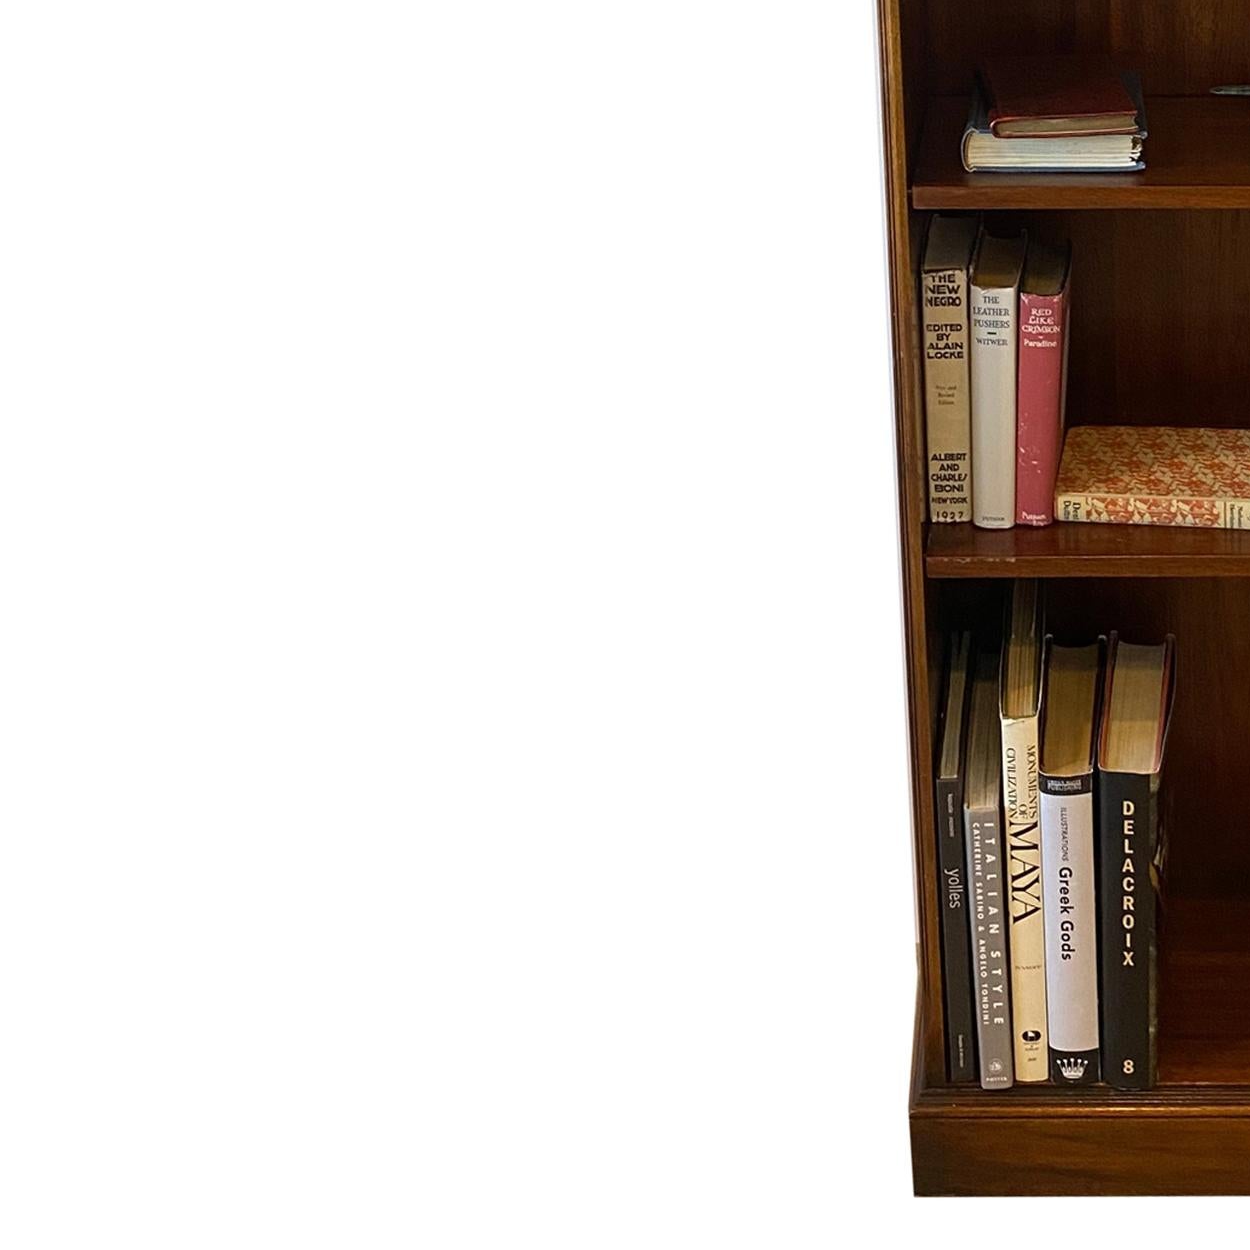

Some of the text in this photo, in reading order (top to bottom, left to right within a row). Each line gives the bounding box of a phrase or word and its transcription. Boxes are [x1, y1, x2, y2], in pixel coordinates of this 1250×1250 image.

[931, 273, 956, 283] THE
[925, 285, 961, 295] NEW
[925, 296, 962, 307] NEGRO
[982, 295, 1000, 304] THE
[972, 307, 1010, 317] LEATHER
[1031, 308, 1053, 316] RED
[926, 323, 963, 331] EDITED
[973, 319, 1011, 329] PUSHERS
[936, 333, 951, 341] BY
[975, 337, 1009, 346] WITWER
[927, 342, 964, 350] ALAIN
[926, 351, 964, 360] LOCKE
[931, 453, 967, 462] ALBERT
[939, 463, 960, 472] AND
[930, 473, 968, 482] CHARLES
[934, 484, 964, 493] BONI
[936, 511, 964, 520] 1927
[1006, 747, 1018, 819] CIVILIZATION
[1060, 806, 1070, 862] ILLUSTRATIONS
[972, 822, 982, 876] CATHERINE
[1009, 819, 1041, 925] MAYA
[944, 868, 963, 909] yolles
[1122, 800, 1135, 967] DELACROIX
[1058, 866, 1074, 914] Greek
[975, 881, 984, 920] SABINO
[984, 822, 1004, 1025] ITALIAN STYLE
[1060, 920, 1076, 961] Gods
[979, 939, 988, 978] ANGELO
[1122, 1059, 1135, 1075] 8
